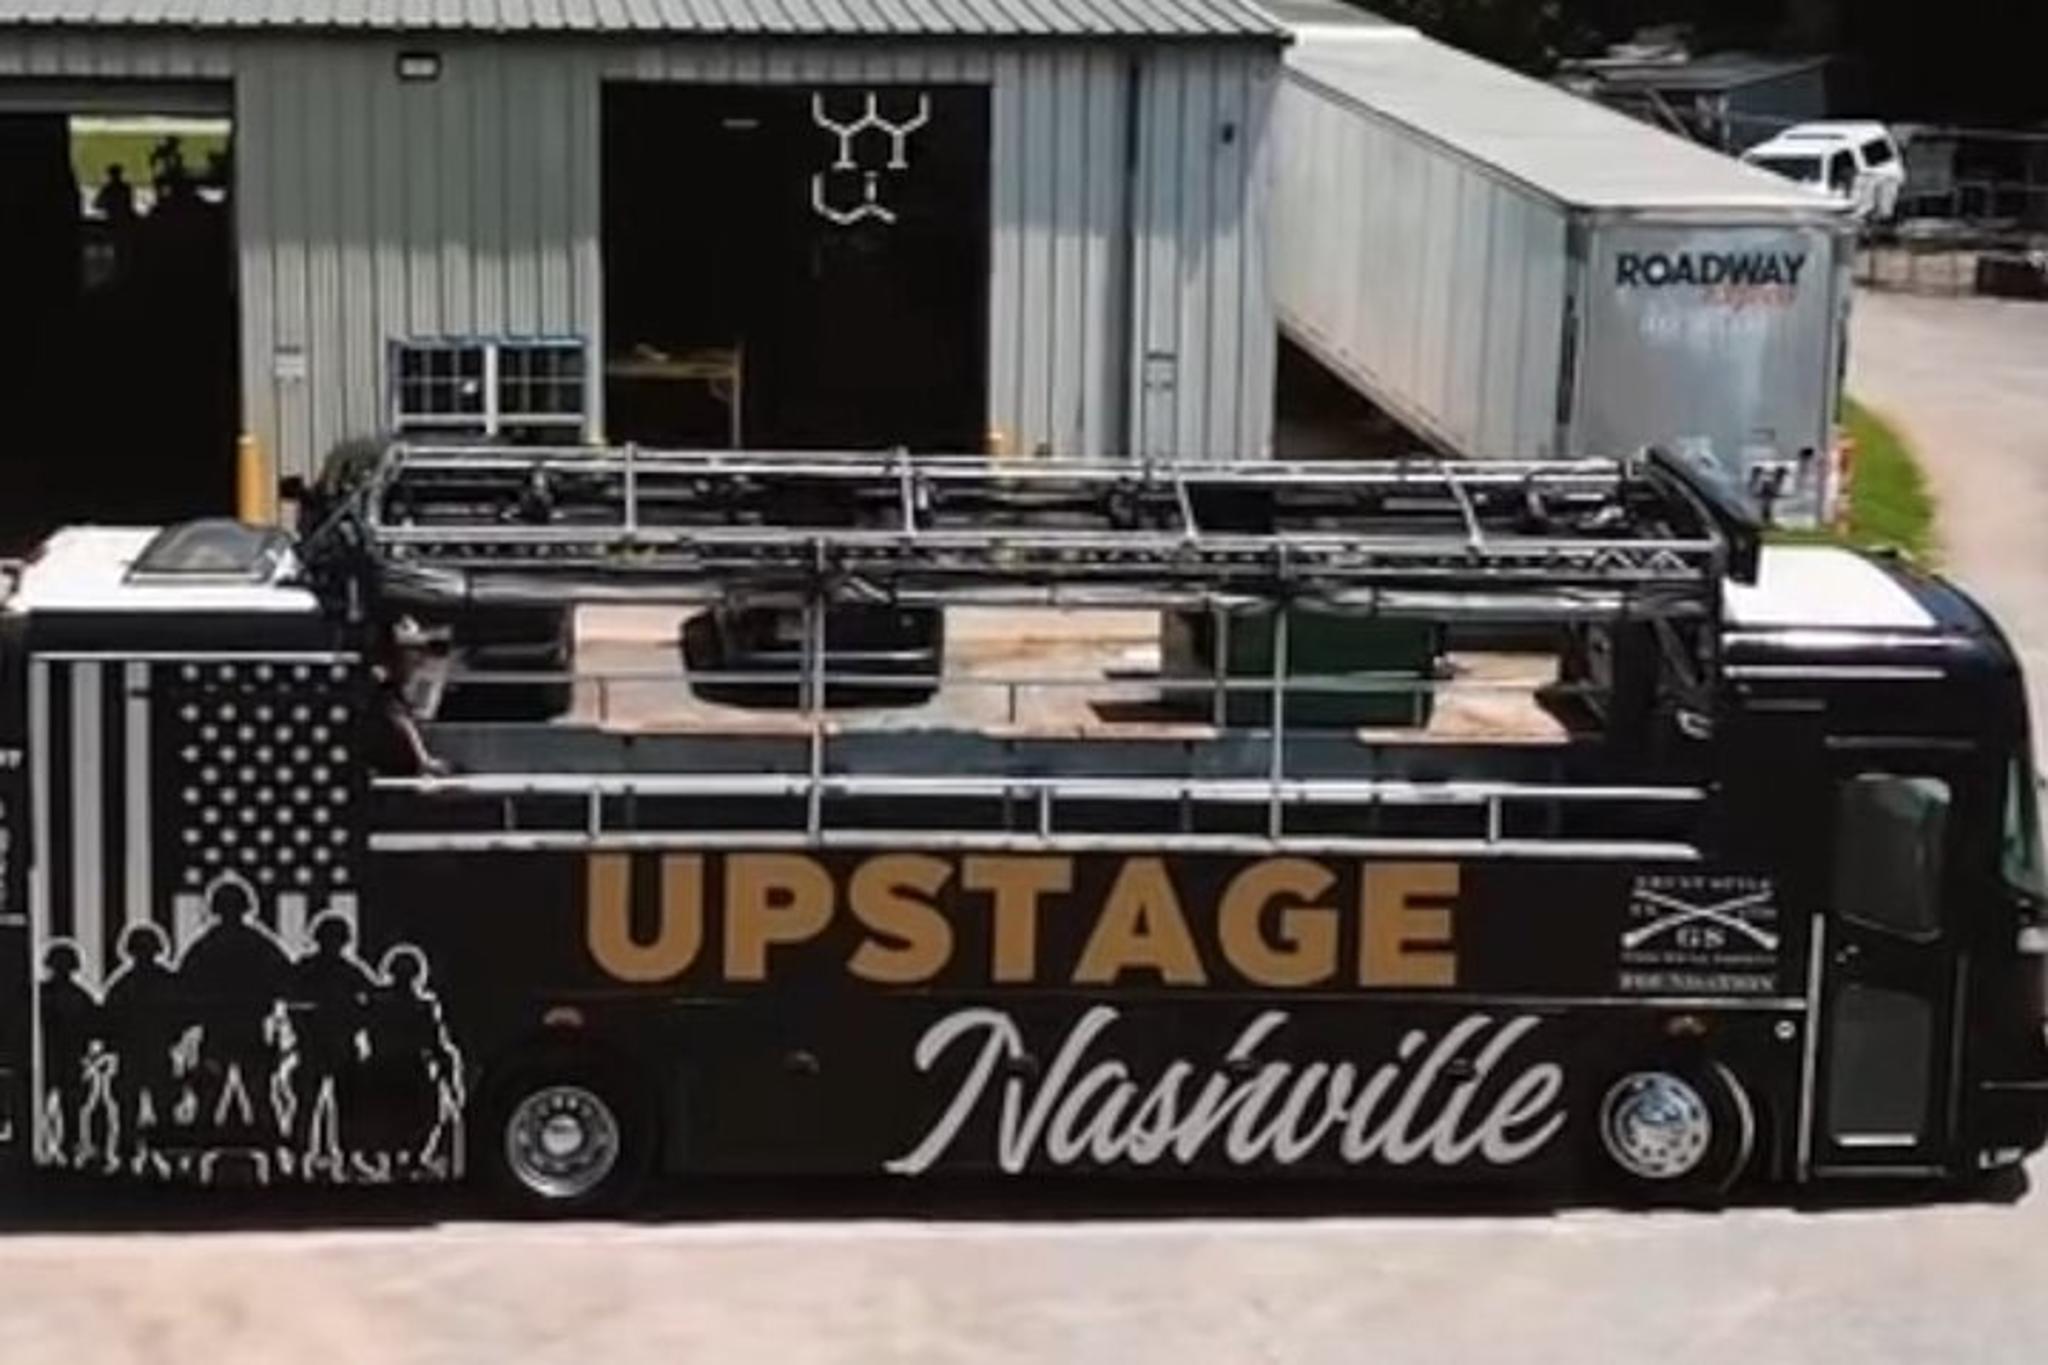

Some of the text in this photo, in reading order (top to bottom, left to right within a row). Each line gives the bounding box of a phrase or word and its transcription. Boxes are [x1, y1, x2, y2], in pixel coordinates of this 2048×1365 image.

[1615, 252, 1806, 287] ROADWAY
[587, 854, 1460, 987] UPSTAGE
[884, 1006, 1566, 1175] Nashville
